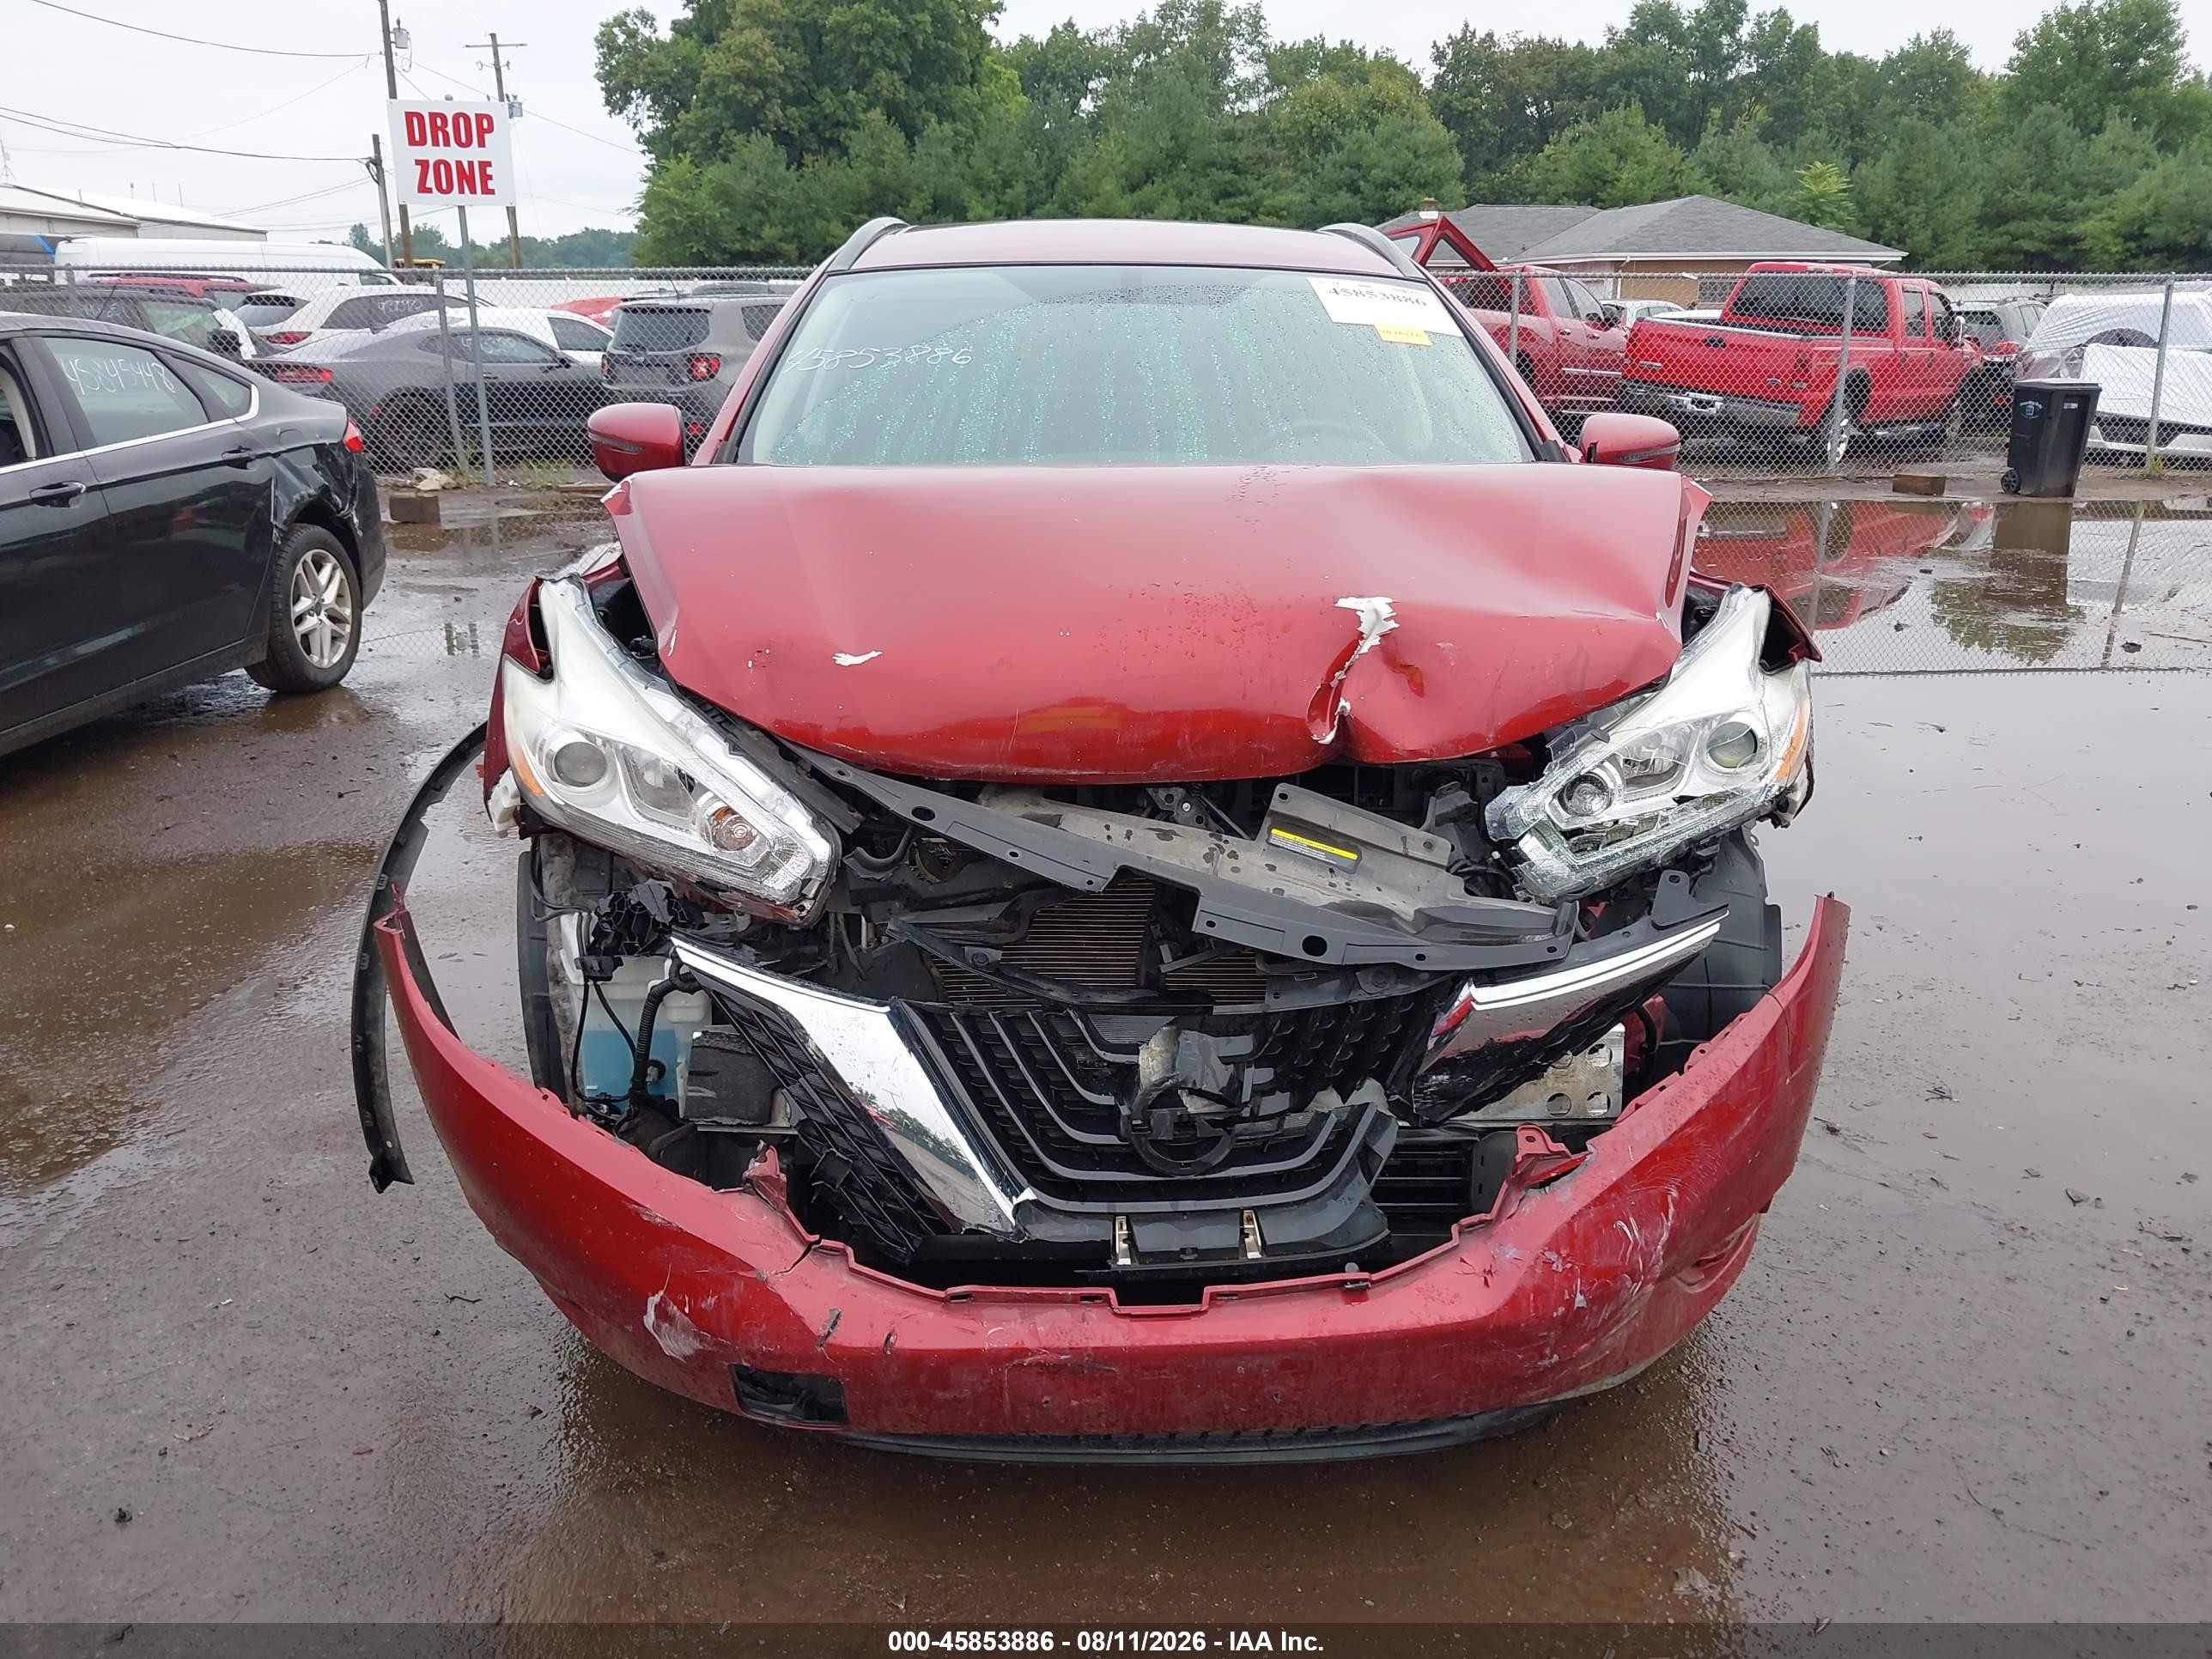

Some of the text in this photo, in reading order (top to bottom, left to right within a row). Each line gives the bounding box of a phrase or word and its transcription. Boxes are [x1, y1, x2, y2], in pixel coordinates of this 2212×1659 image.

[404, 111, 495, 149] DROP
[414, 158, 495, 195] ZONE
[782, 343, 973, 374] 45853886
